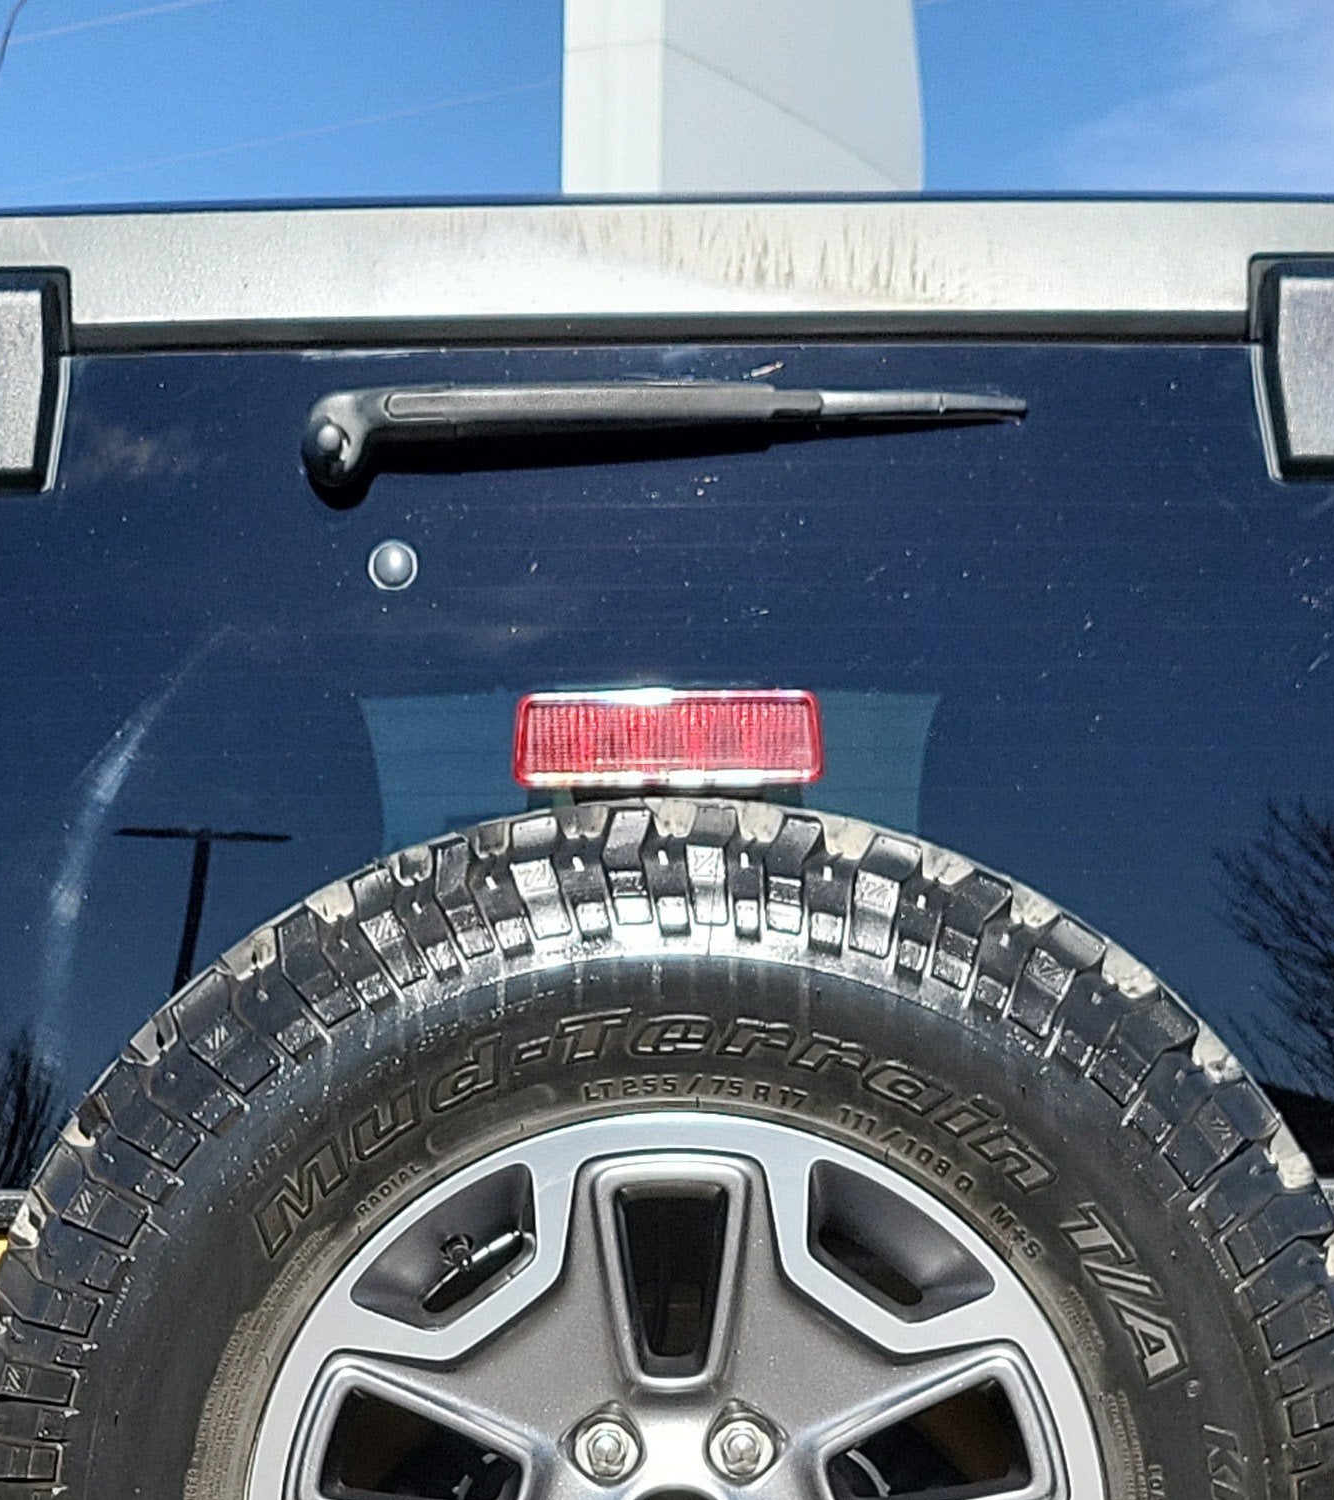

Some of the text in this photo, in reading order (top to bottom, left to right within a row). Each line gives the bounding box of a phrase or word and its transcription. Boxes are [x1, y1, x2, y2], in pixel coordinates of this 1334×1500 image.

[251, 1006, 1058, 1260] Mud-Terrain
[1056, 1192, 1192, 1387] T/A
[355, 1161, 422, 1218] RADIAL
